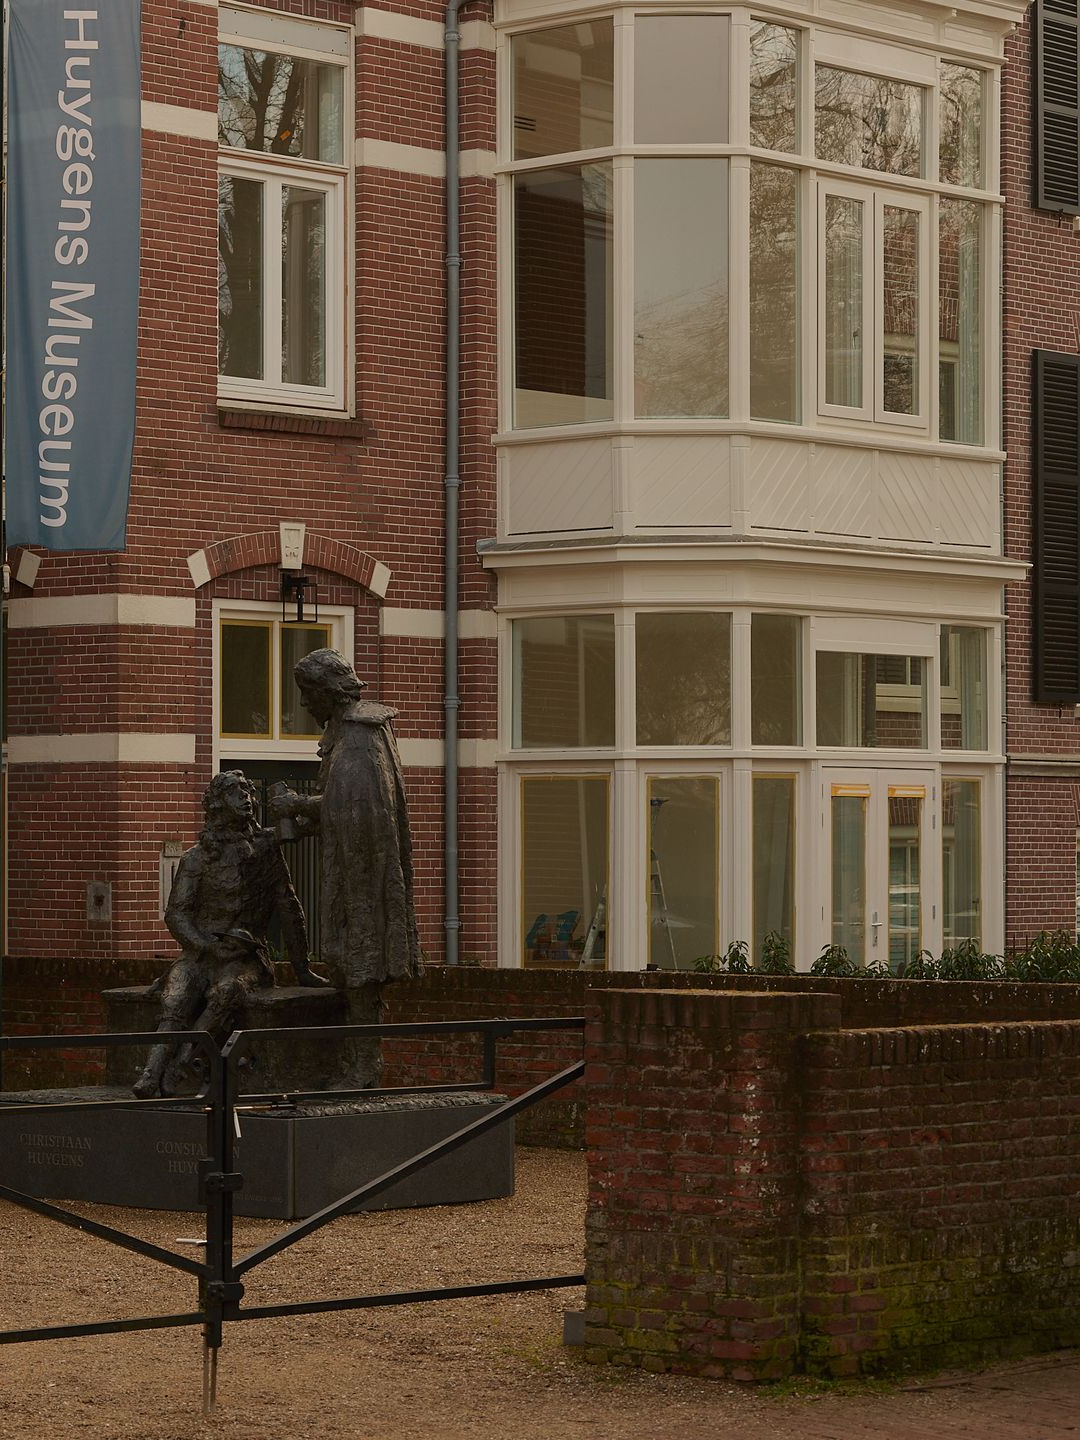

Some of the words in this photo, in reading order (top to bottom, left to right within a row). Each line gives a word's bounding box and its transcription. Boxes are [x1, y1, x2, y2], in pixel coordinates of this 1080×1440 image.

[54, 10, 99, 265] Huygens
[39, 280, 96, 528] Museum
[19, 1133, 93, 1151] CHRISTIAAN
[27, 1151, 85, 1168] HUYGENS
